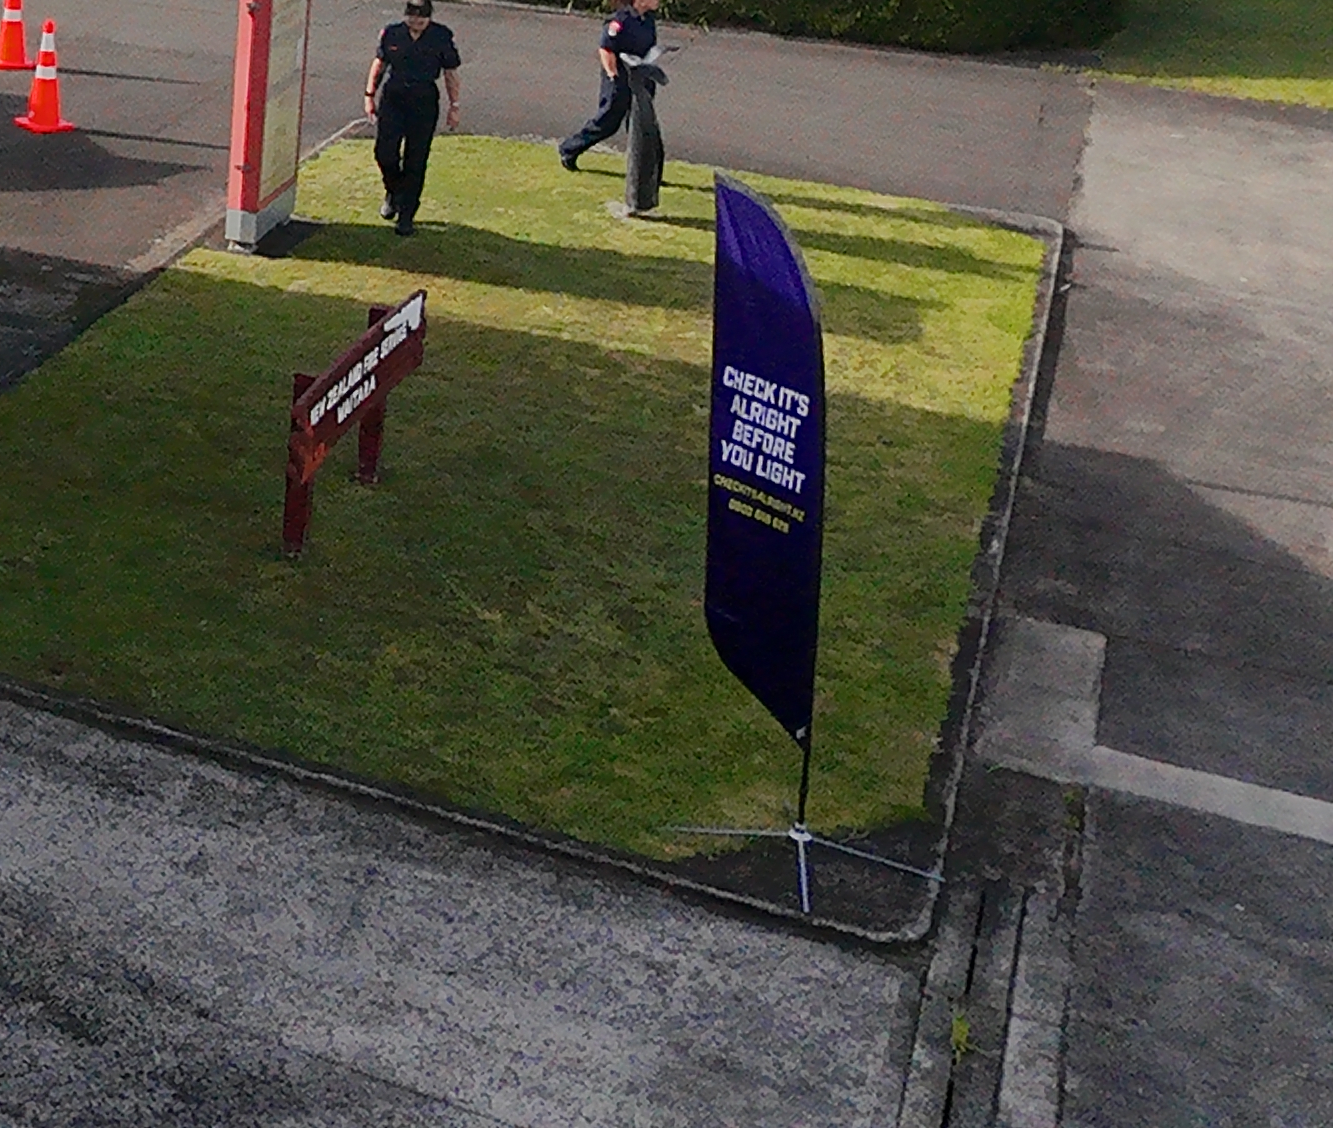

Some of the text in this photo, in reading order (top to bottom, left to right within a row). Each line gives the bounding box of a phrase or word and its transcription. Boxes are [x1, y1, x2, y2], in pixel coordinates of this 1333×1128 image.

[722, 365, 811, 417] CHECK IT'S
[730, 394, 802, 439] ALRIGHT
[731, 420, 797, 464] BEFORE
[720, 439, 806, 494] YOU LIGHT
